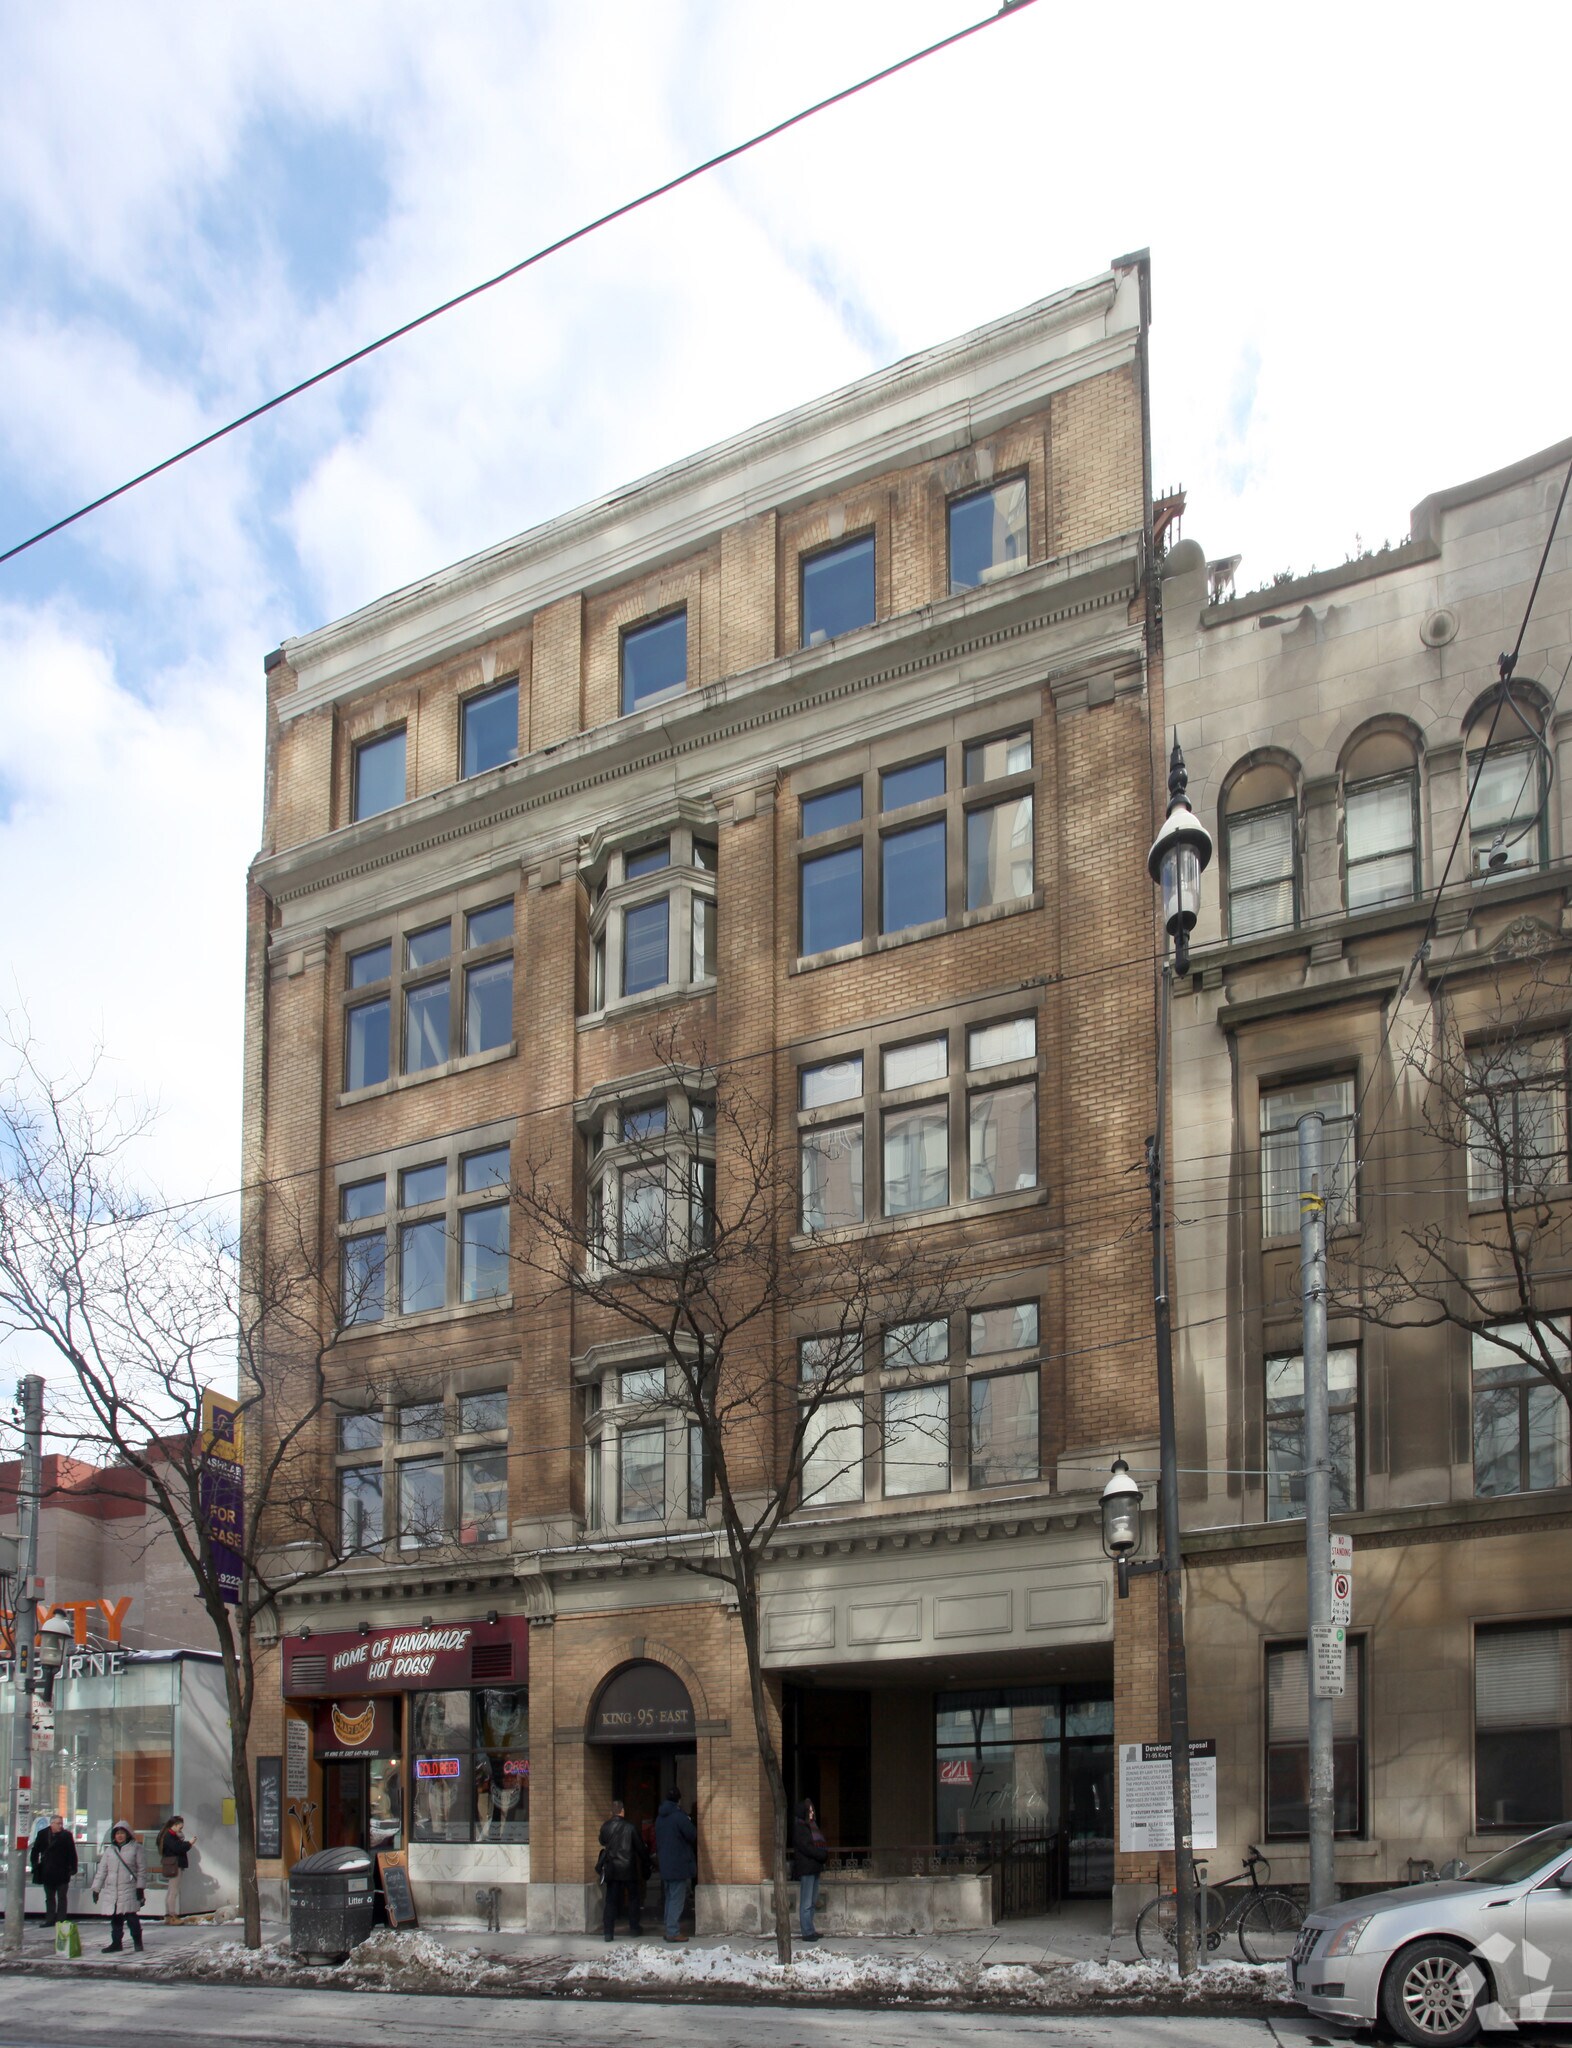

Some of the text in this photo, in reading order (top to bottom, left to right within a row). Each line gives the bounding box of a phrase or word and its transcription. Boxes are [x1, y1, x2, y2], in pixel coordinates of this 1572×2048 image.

[210, 1504, 236, 1524] FOR
[208, 1527, 242, 1547] EASE
[1331, 1547, 1351, 1556] STANDING
[333, 1629, 471, 1671] HOME OF HANDMADE
[368, 1656, 436, 1680] HOT DOGS!
[602, 1708, 688, 1726] KING 95 EAST
[1145, 1741, 1208, 1753] Developm oposal
[419, 1761, 458, 1776] COLD BEER
[348, 1896, 363, 1906] Litter
